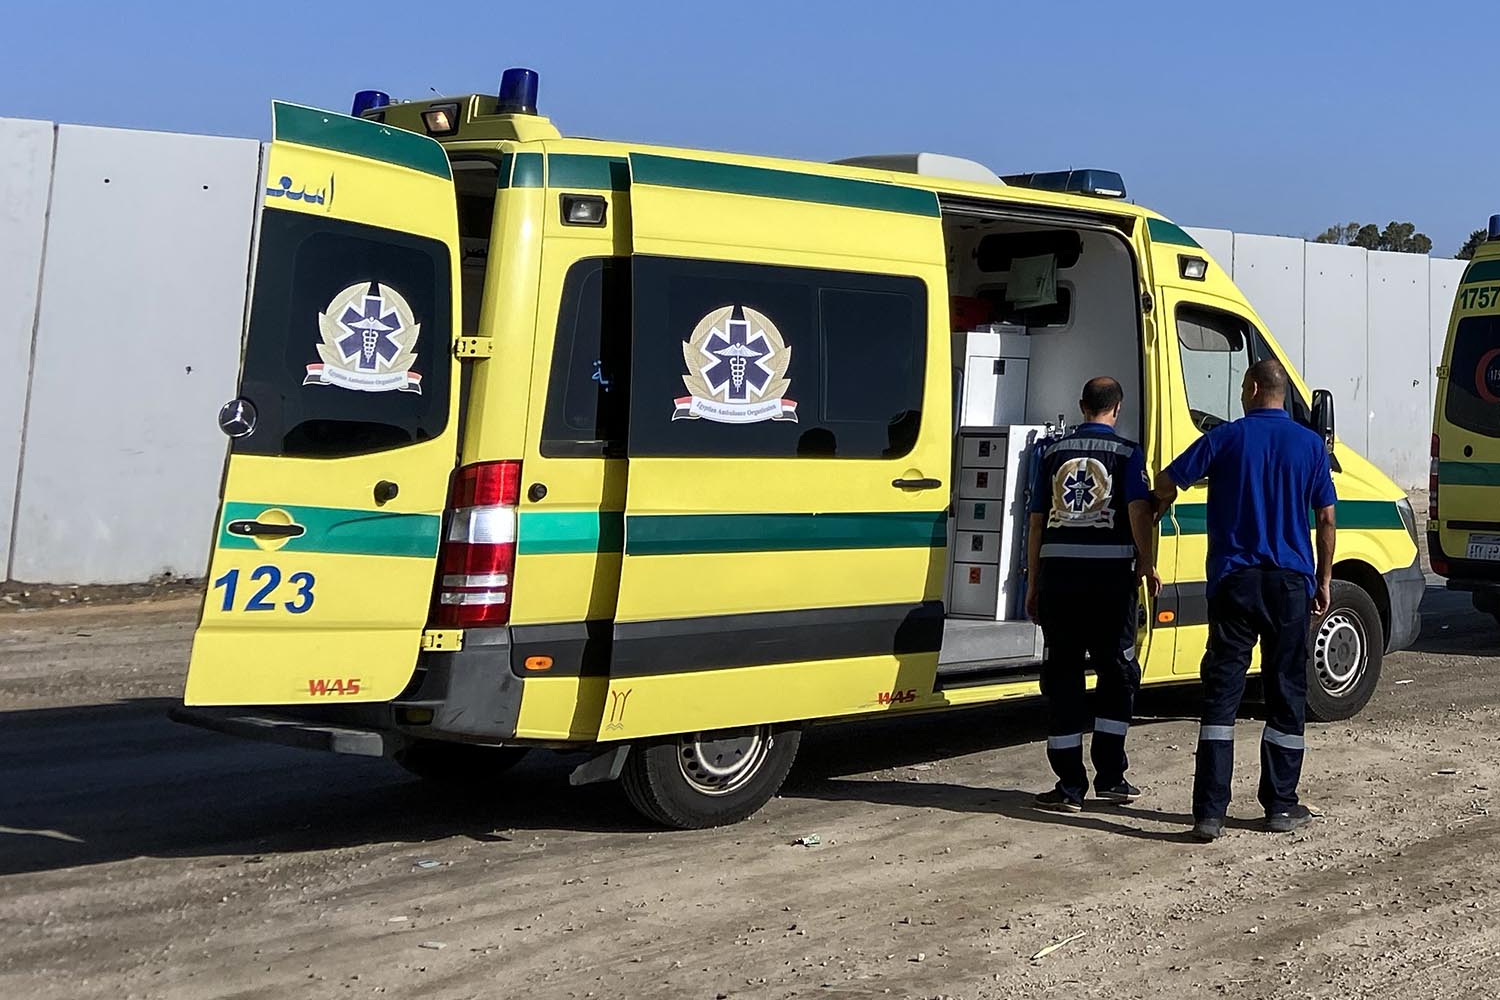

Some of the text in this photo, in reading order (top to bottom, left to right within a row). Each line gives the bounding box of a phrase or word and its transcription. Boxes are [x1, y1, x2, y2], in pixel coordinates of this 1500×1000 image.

[213, 565, 317, 614] 123
[308, 679, 361, 696] WAS
[878, 689, 917, 705] WAS
